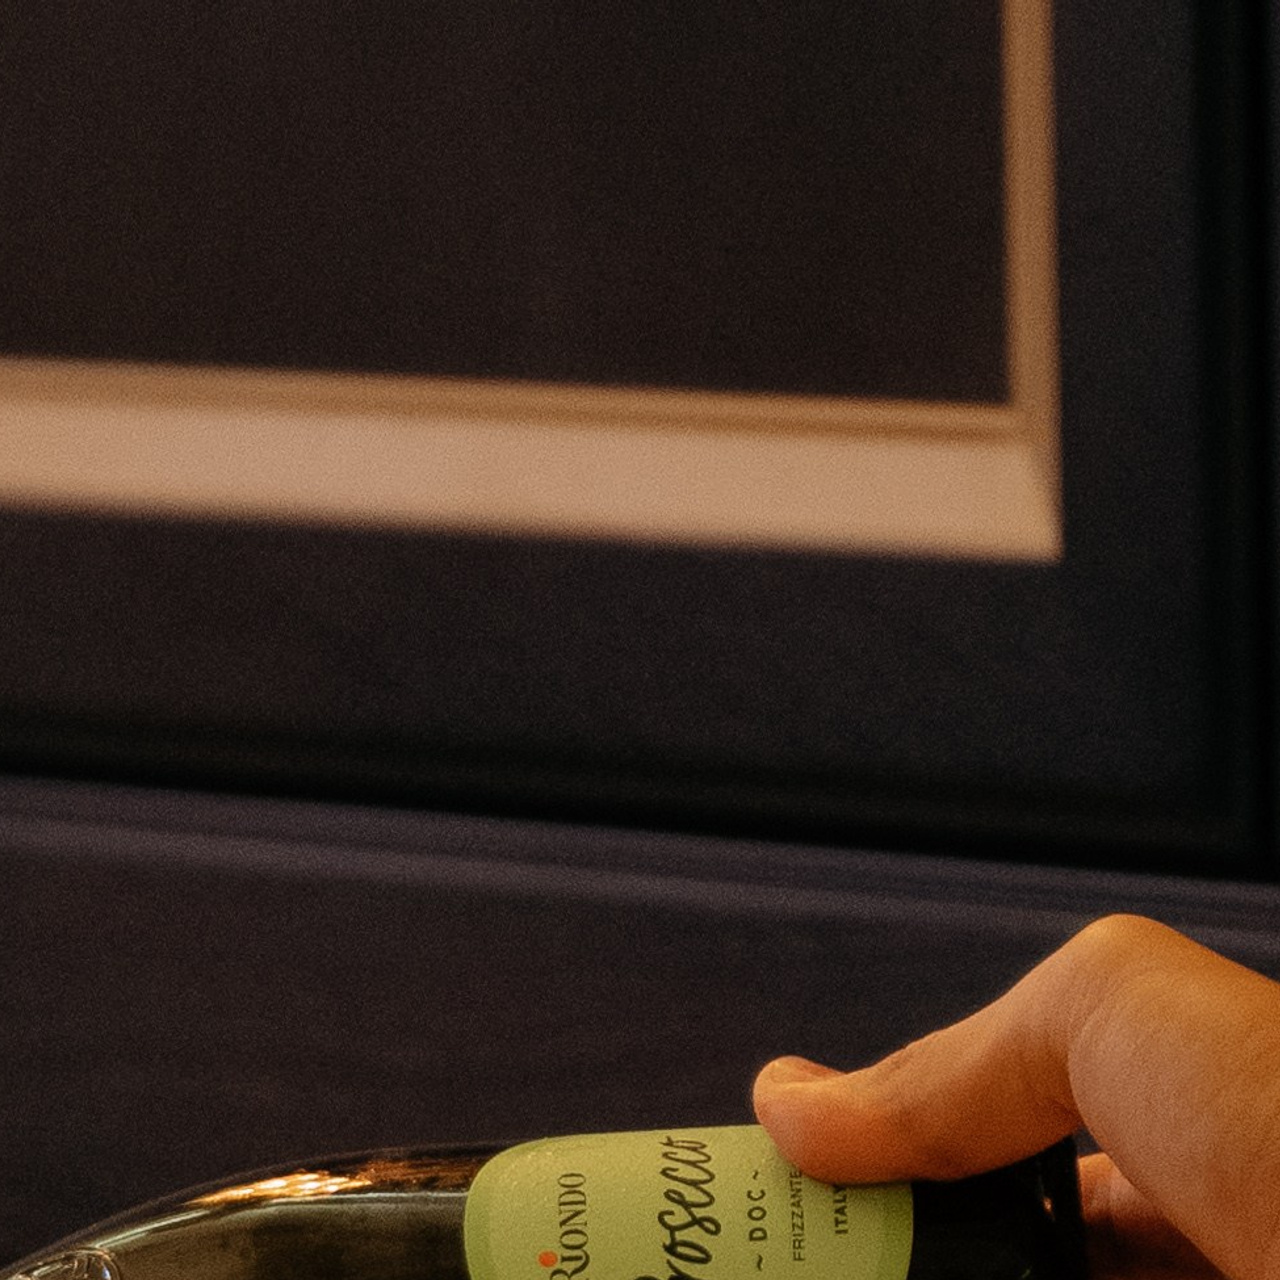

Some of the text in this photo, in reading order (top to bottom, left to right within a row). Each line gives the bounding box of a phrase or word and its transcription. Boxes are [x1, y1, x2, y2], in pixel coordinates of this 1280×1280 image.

[747, 1186, 768, 1242] DOC
[789, 1169, 807, 1262] FRIZZANTE
[832, 1185, 849, 1235] ITALY
